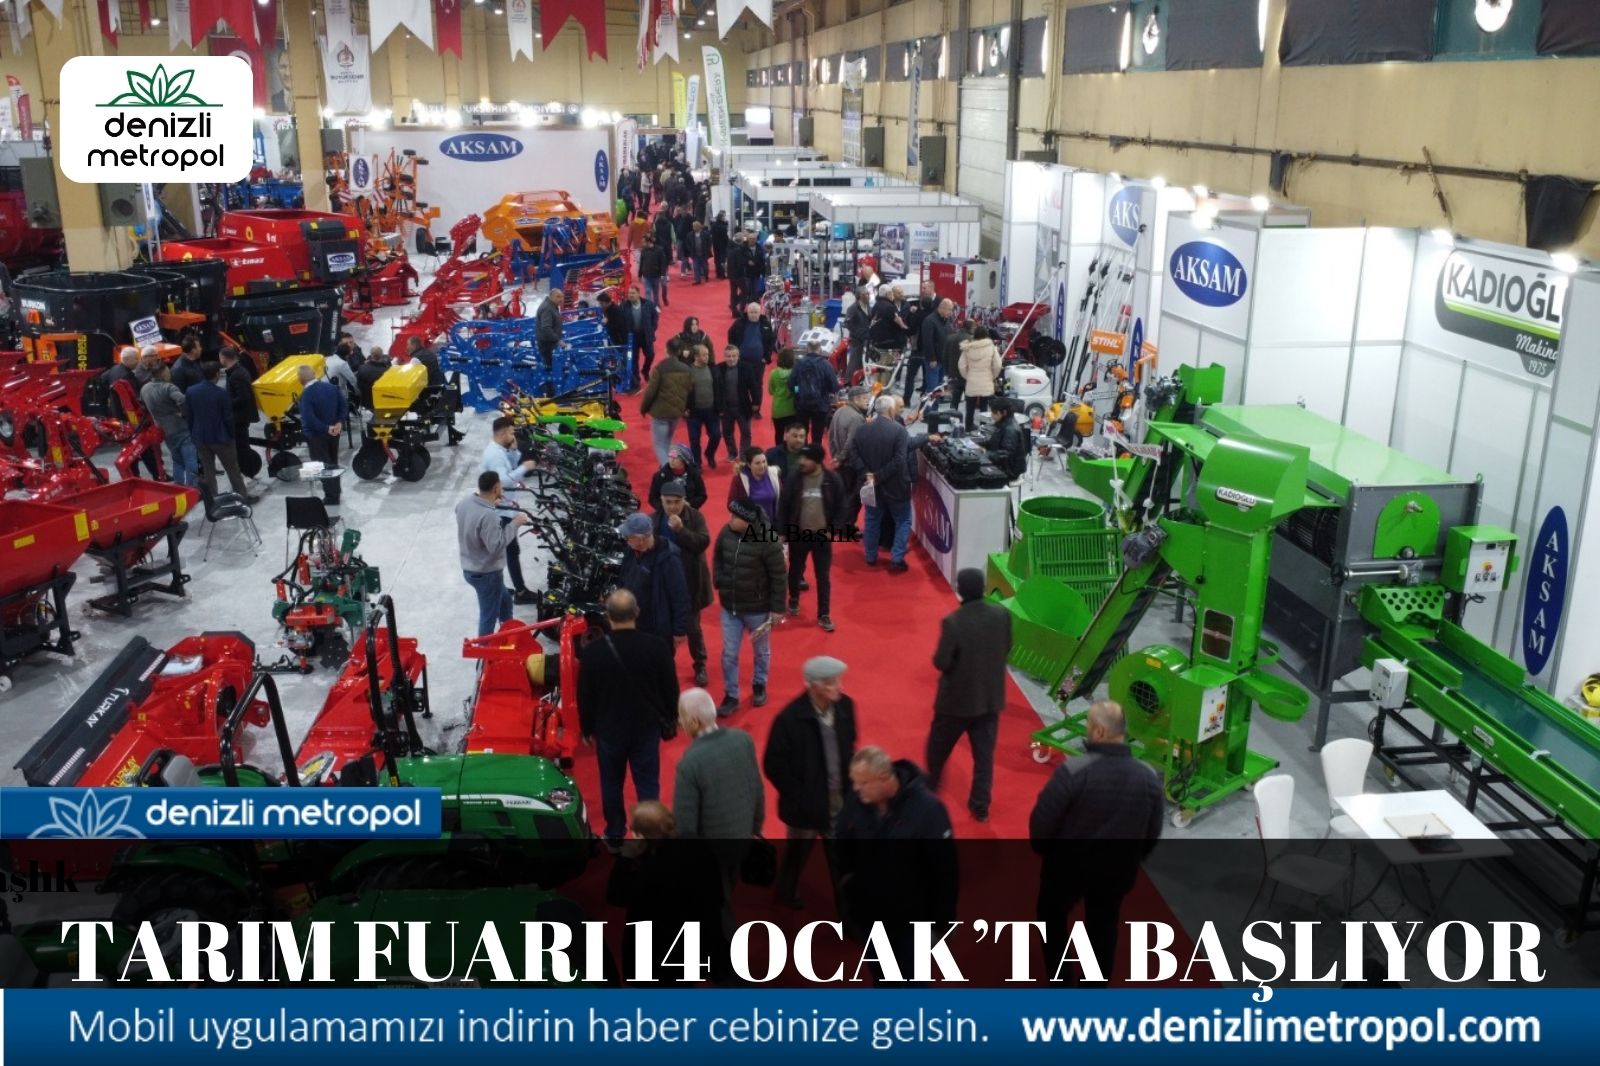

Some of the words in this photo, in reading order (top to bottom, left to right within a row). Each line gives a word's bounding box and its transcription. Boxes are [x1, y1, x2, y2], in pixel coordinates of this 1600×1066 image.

[446, 140, 519, 155] AKSAM
[1174, 253, 1242, 297] AKSAM
[1446, 262, 1560, 323] KADIOĞL
[1092, 336, 1120, 349] STIHL
[1528, 359, 1548, 376] 1975
[1528, 530, 1559, 656] AKSAM
[86, 693, 120, 728] TURKAY
